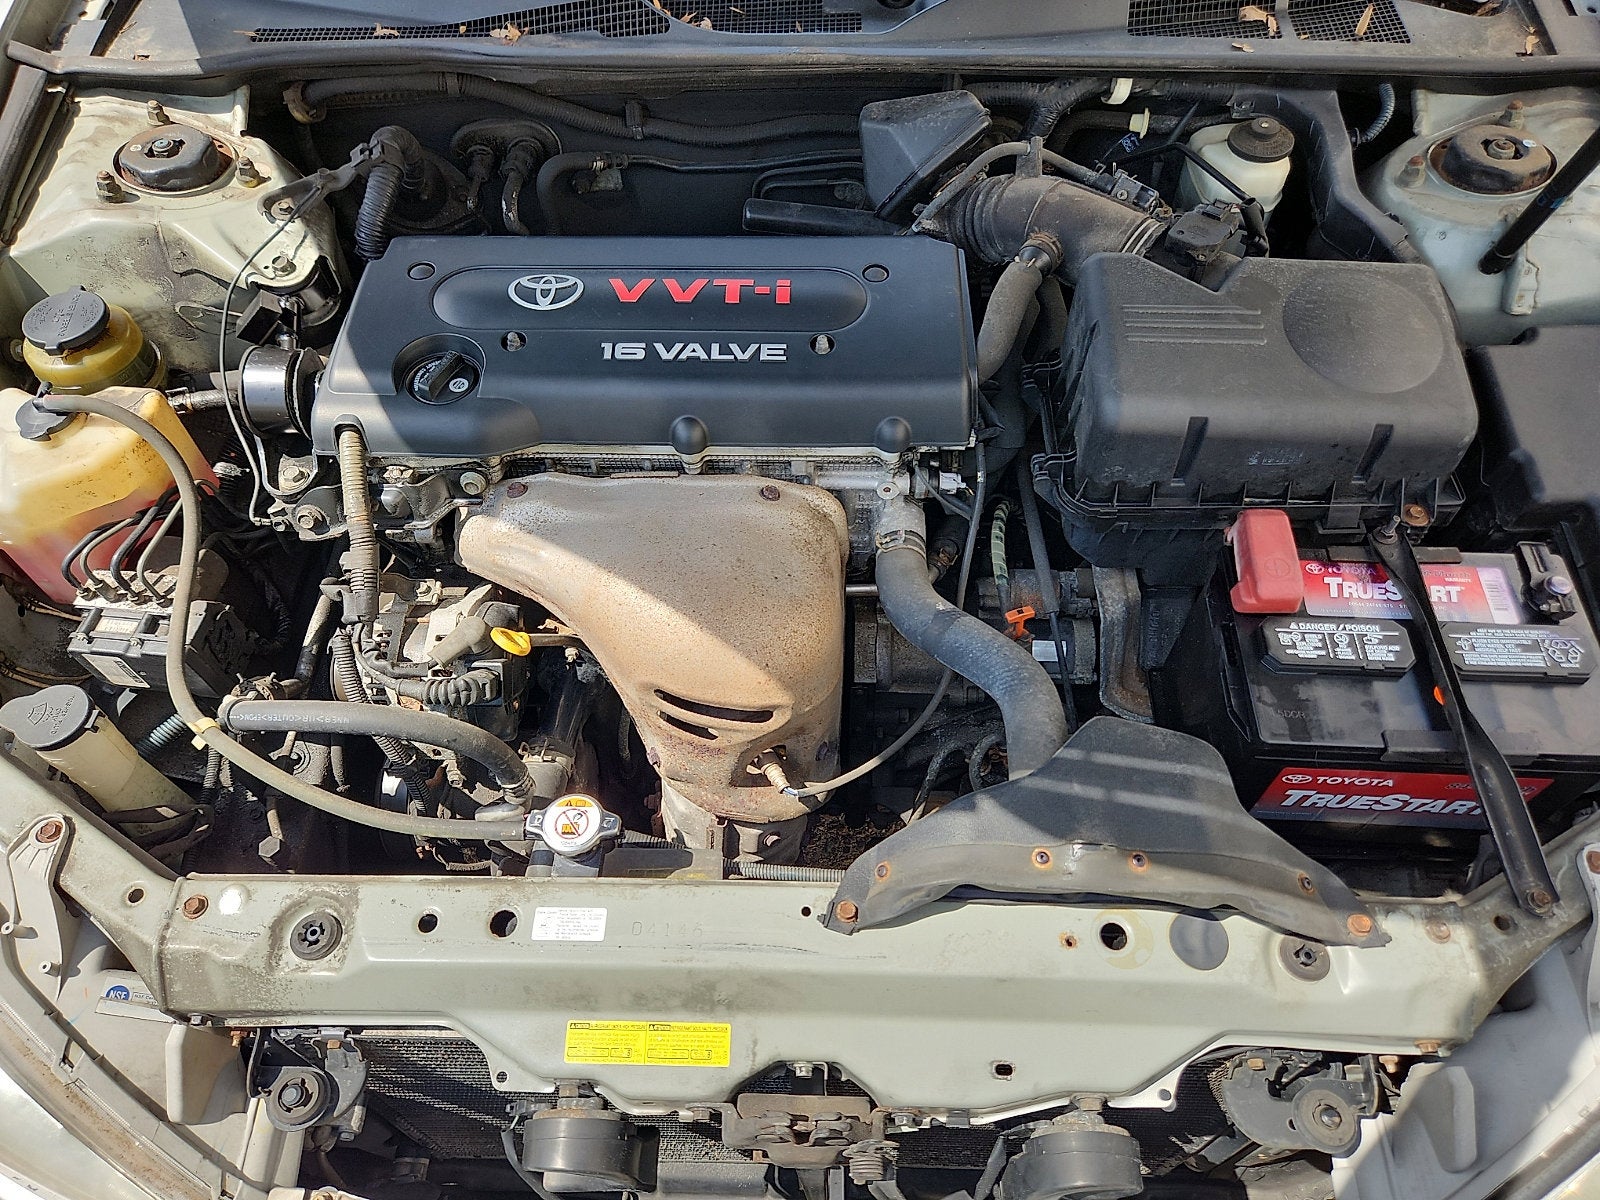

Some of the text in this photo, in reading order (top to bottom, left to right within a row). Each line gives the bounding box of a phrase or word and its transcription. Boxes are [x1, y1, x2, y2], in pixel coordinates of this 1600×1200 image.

[608, 278, 792, 304] VVT-i
[601, 342, 788, 362] 16 VALVE
[1326, 563, 1377, 576] TOYOTA
[1298, 622, 1337, 631] DANGER
[1344, 624, 1380, 633] POISON
[1317, 776, 1394, 787] TOYOTA
[109, 990, 128, 1000] NSF
